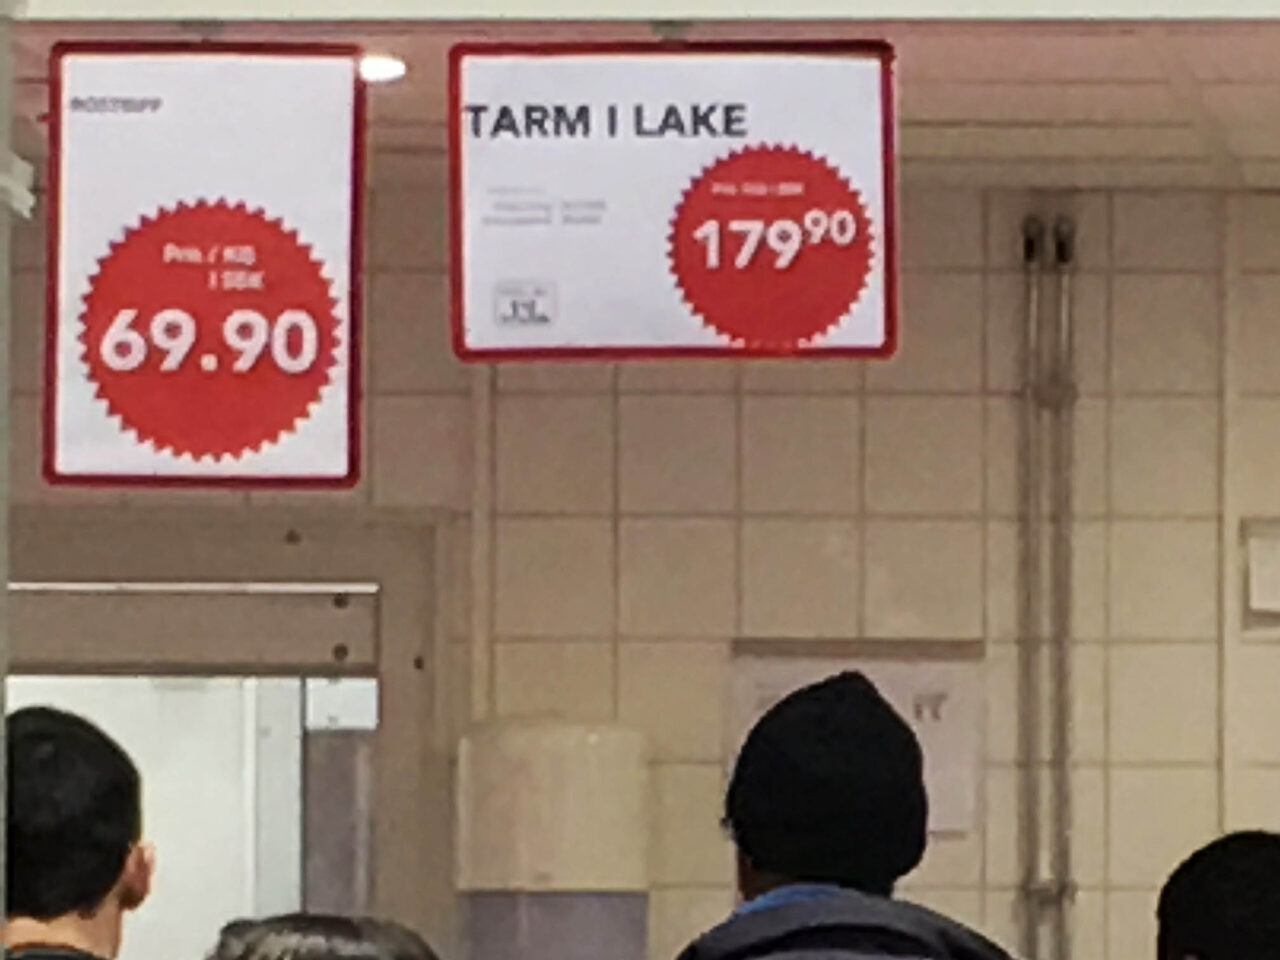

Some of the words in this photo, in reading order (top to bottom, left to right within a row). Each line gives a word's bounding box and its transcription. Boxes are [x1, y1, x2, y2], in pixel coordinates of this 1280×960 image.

[466, 104, 591, 138] TARM
[607, 104, 619, 138] I
[634, 104, 748, 138] LAKE
[100, 308, 319, 374] 69.90
